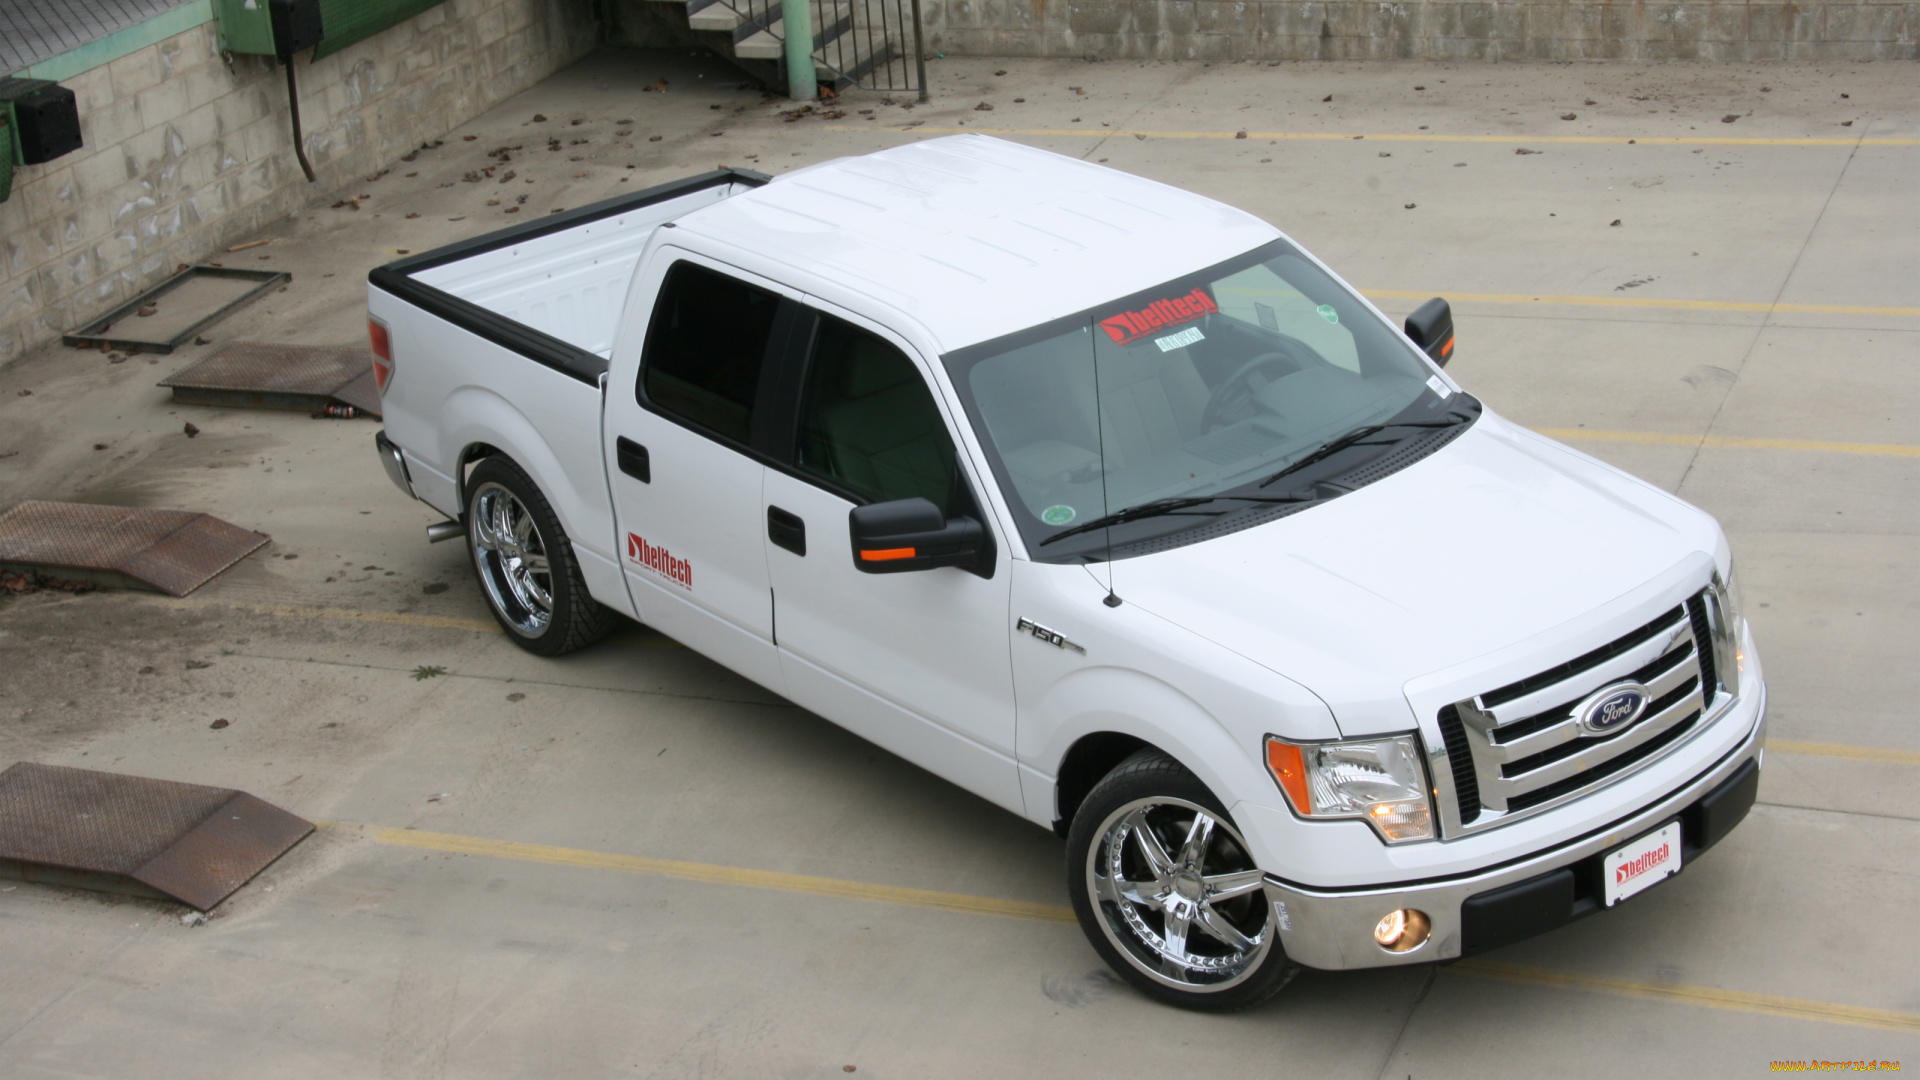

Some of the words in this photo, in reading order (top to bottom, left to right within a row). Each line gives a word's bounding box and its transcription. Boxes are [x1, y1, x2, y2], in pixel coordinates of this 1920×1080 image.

[1125, 288, 1217, 332] belltech
[643, 538, 692, 586] belltech
[1602, 698, 1632, 724] Ford
[1629, 841, 1669, 877] belltech
